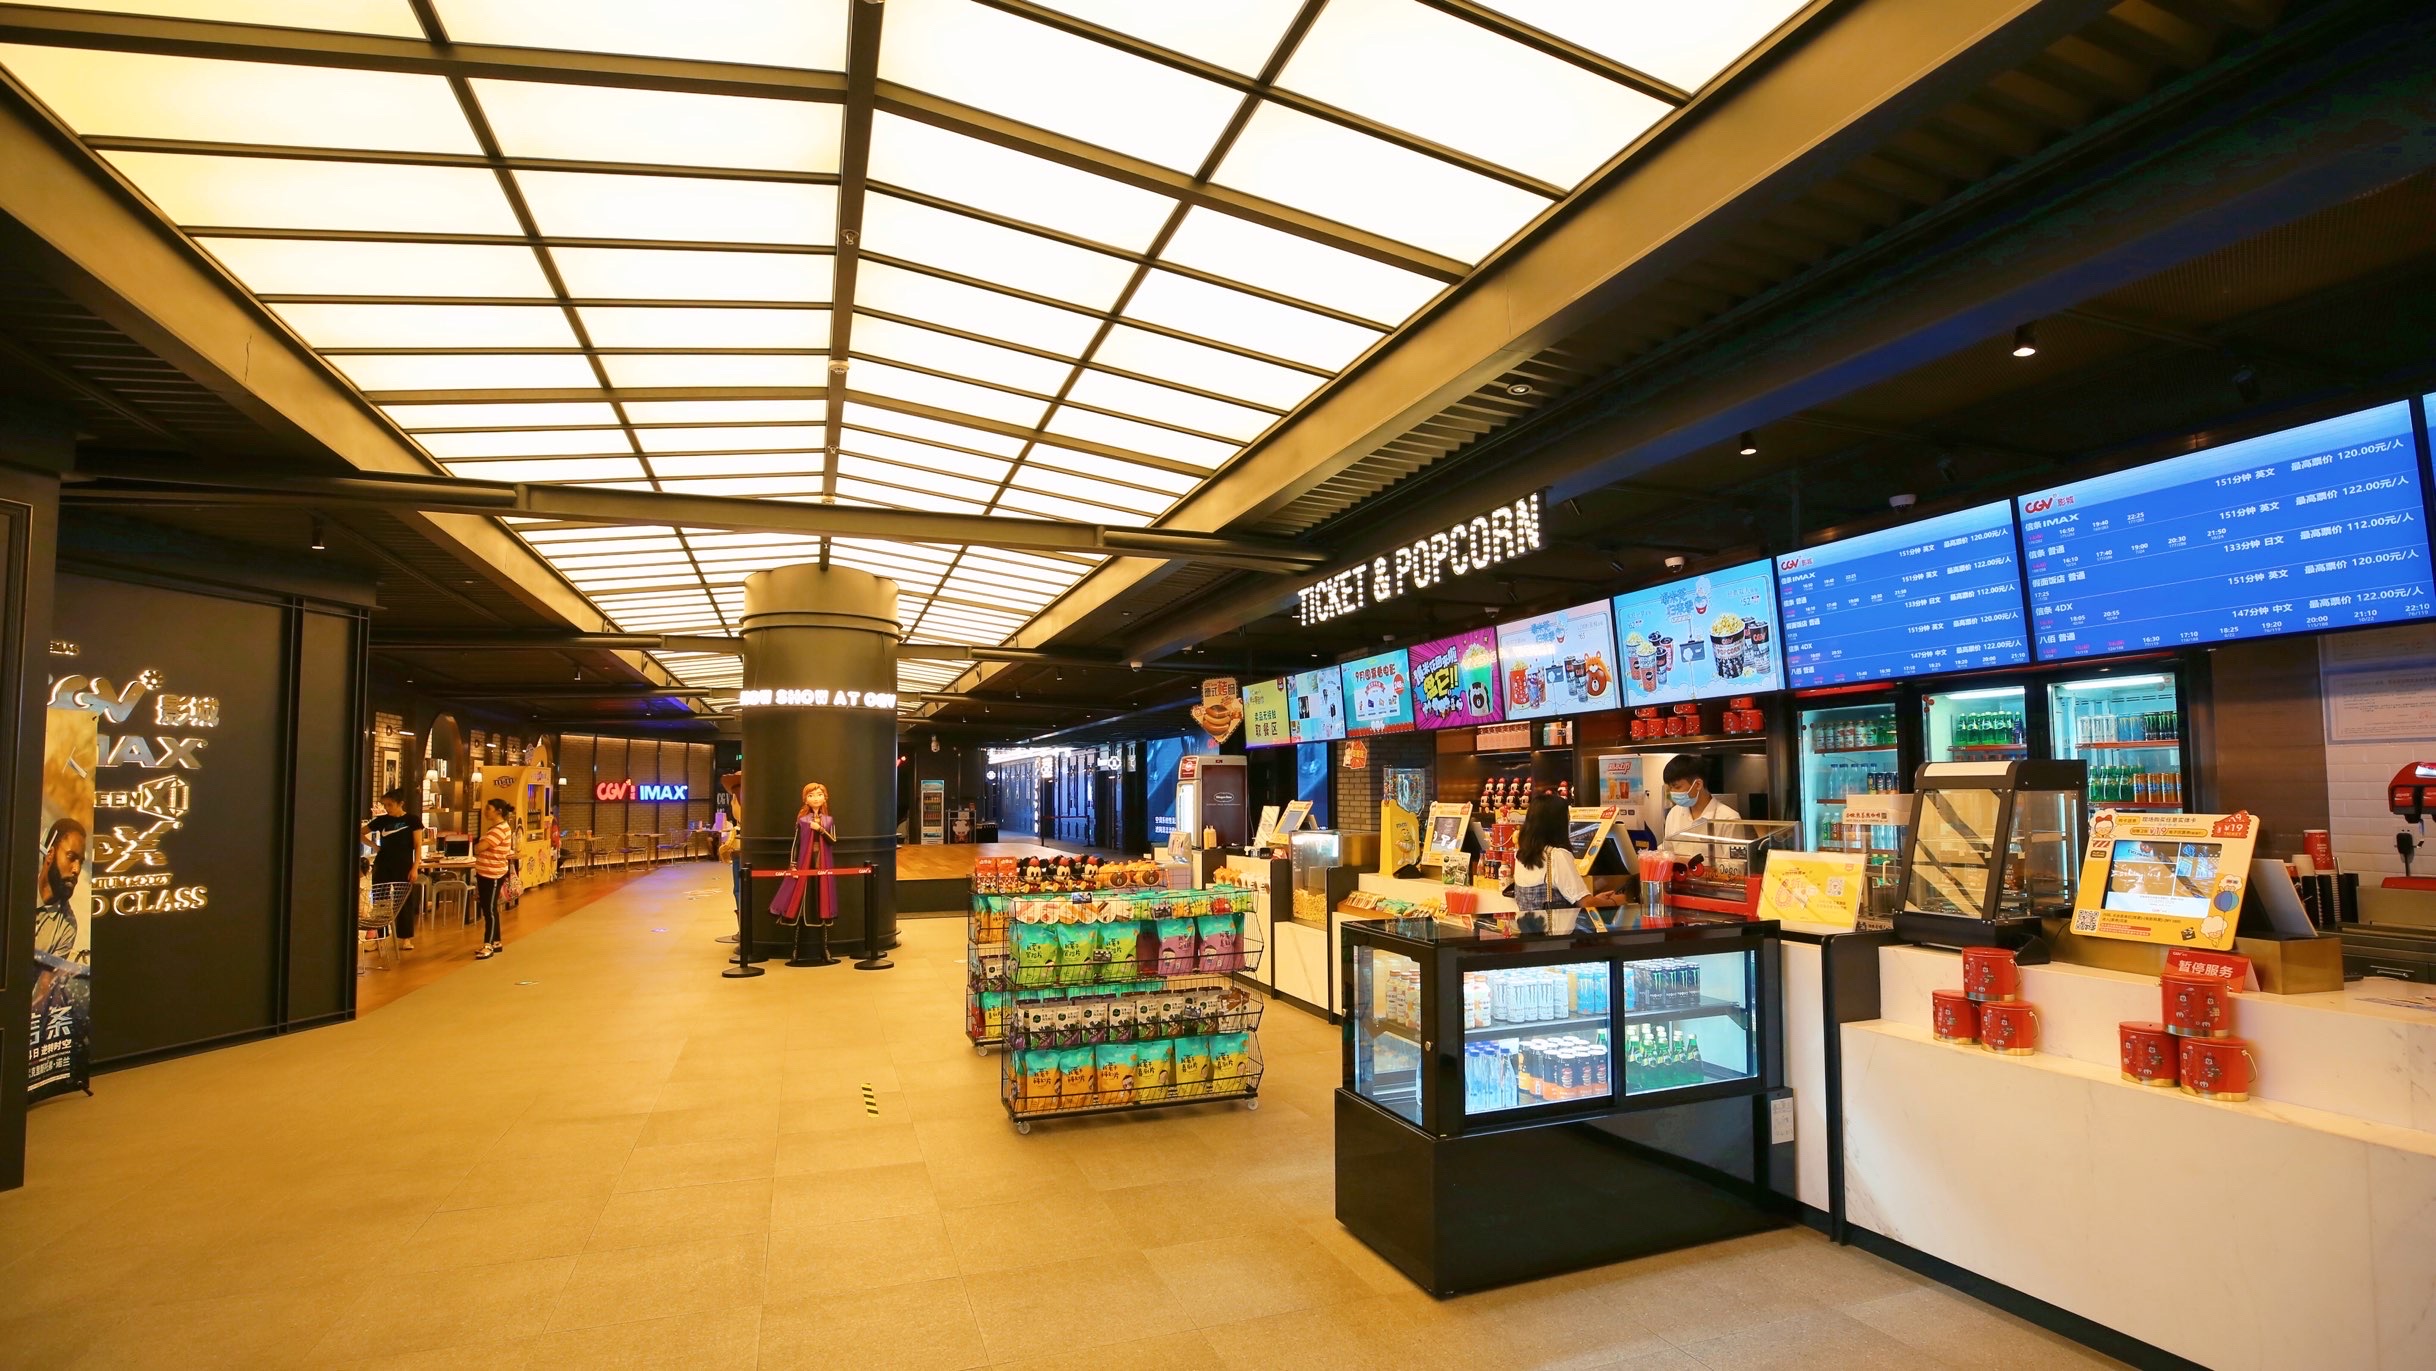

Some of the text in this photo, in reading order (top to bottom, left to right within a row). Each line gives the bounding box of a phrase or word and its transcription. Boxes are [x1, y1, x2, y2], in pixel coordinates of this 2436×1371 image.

[2215, 438, 2404, 487] 151分钟 英文 最高票价 120.00元/人
[2025, 498, 2053, 514] CGV
[2219, 475, 2409, 519] 151分钟 英文 最高票价 122.00元/人
[2092, 520, 2109, 528] 19:40
[2127, 512, 2145, 520] 22:25
[2223, 512, 2414, 553] 133分钟 日文 最高票价 112.00元/人
[2029, 545, 2065, 559] 信条 普通
[2096, 549, 2113, 558] 17:40
[2131, 543, 2148, 551] 19:00
[2207, 528, 2226, 537] 21:50
[1298, 493, 1540, 627] TICKET & POPCORN
[1781, 559, 1799, 571] CGV
[2228, 548, 2419, 585] 151分钟 英文 最高票价 120.00元/人
[2068, 571, 2086, 582] 普通
[2055, 603, 2073, 613] 4DX
[2232, 585, 2424, 618] 147分钟 中文 最高票价 122.00元/人
[2103, 610, 2120, 618] 20:55
[2220, 626, 2239, 634] 18:25
[2262, 621, 2282, 629] 19:20
[2306, 615, 2328, 624] 20:00
[2354, 609, 2378, 618] 21:10
[2405, 602, 2430, 612] 22:10
[2059, 632, 2076, 643] 普通
[1801, 643, 1813, 651] 4DX
[1935, 649, 1947, 657] 中文
[775, 689, 829, 706] SHOW
[833, 690, 861, 707] AT
[597, 782, 627, 801] CGV
[640, 785, 686, 801] IMAX
[2223, 823, 2244, 832] ¥19
[91, 821, 169, 873] DX
[113, 885, 209, 917] CLASS
[2178, 959, 2234, 979] 暂停服务
